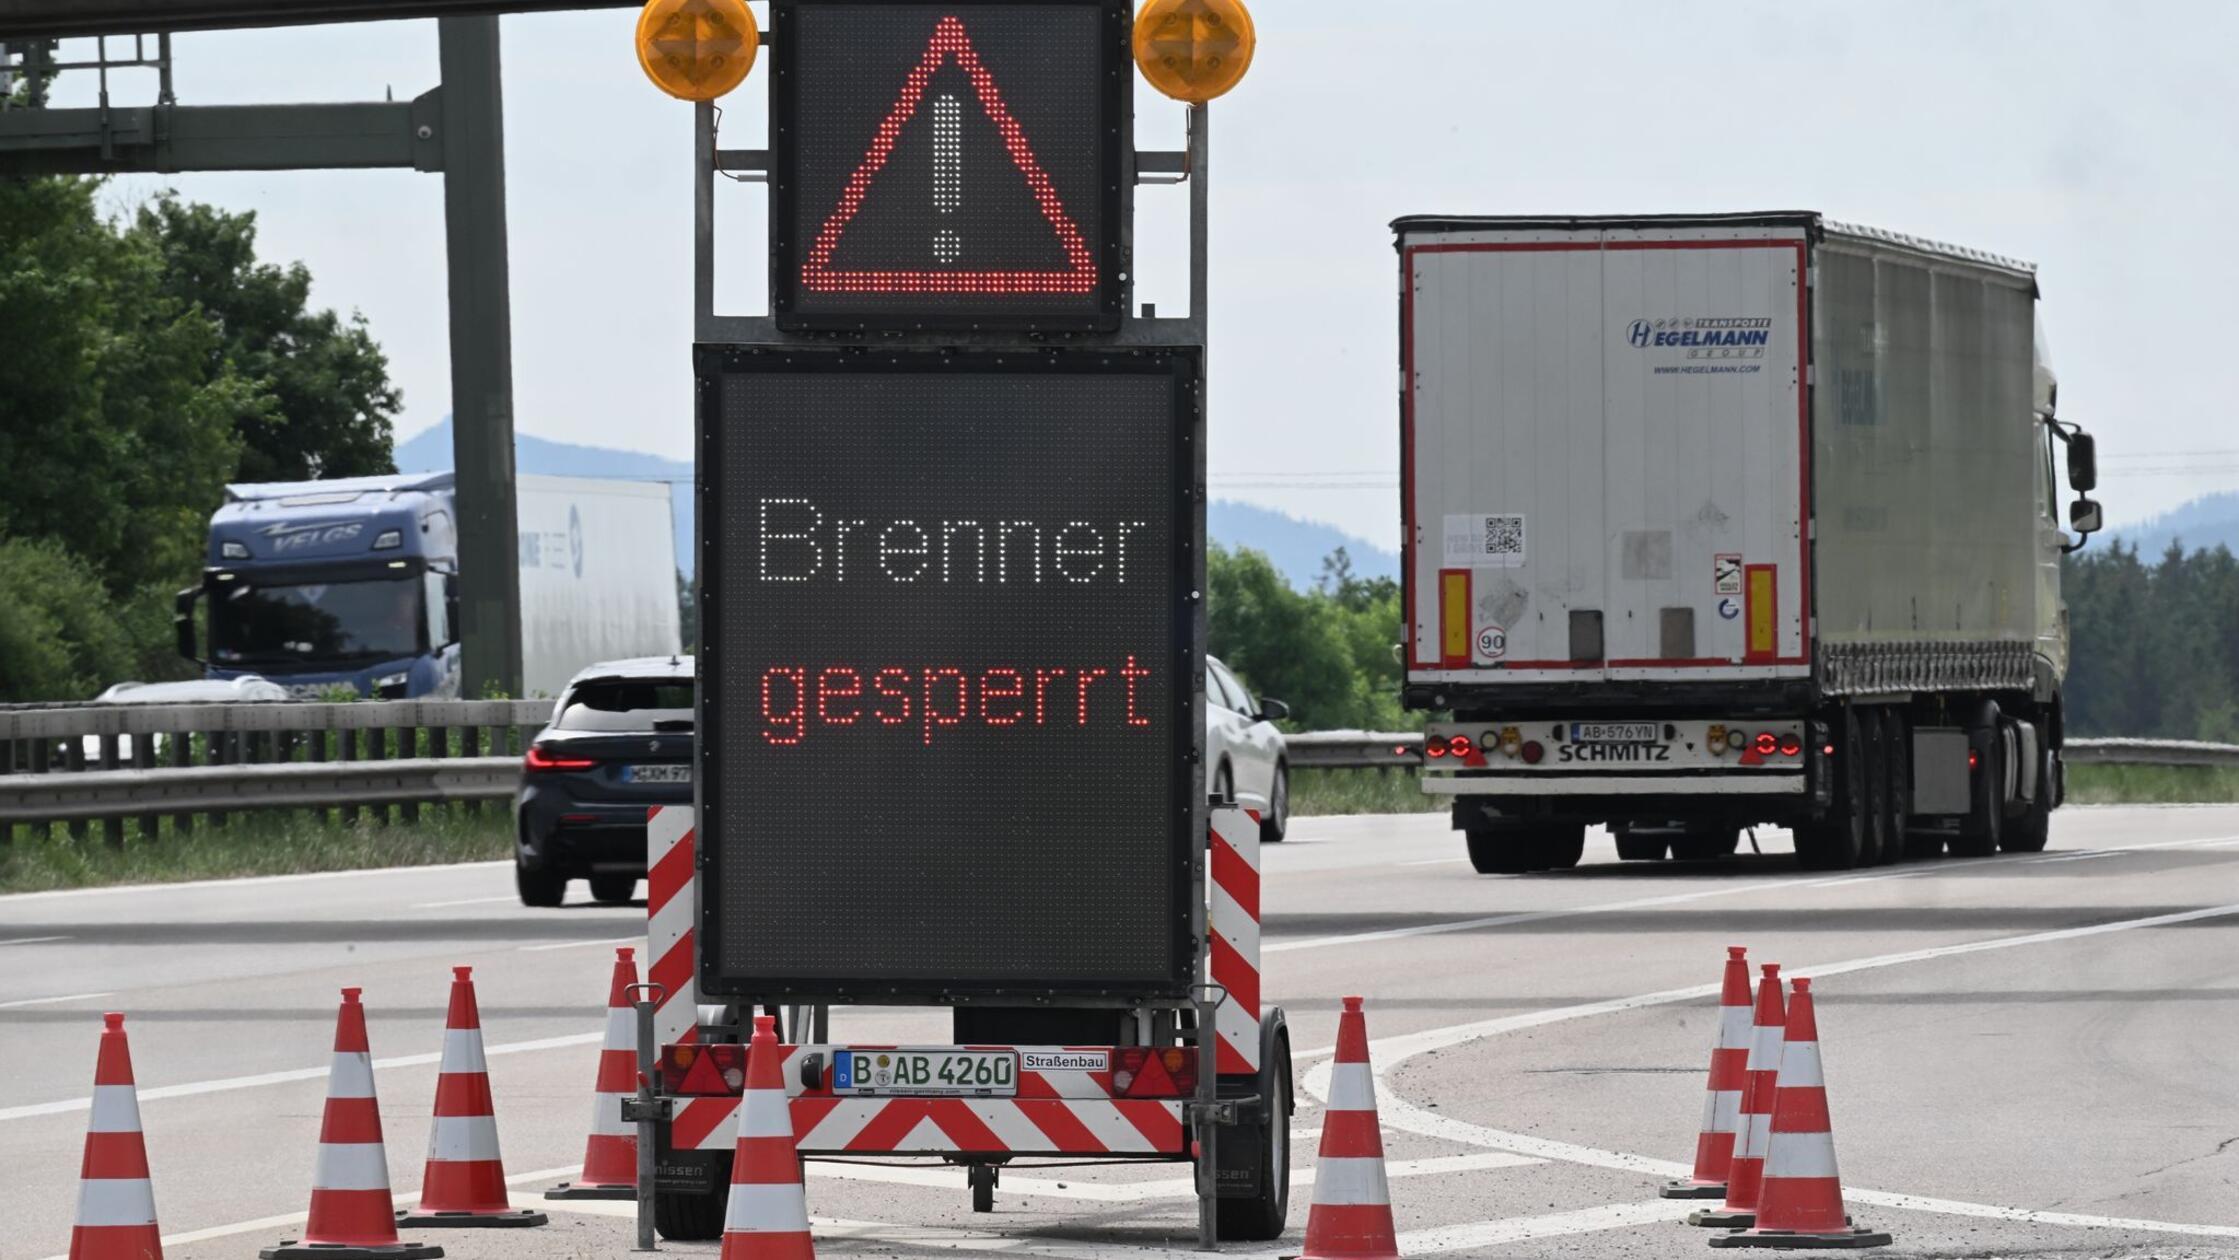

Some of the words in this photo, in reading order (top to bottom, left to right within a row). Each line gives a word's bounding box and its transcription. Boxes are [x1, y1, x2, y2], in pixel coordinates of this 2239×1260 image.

[1696, 319, 1770, 328] TRANSPORTE
[1629, 320, 1769, 347] HEGELMANN
[761, 498, 1146, 583] Brenner
[1481, 635, 1505, 649] 90
[762, 654, 1150, 745] gesperrt
[1559, 744, 1670, 761] SCHMITZ
[1026, 1055, 1104, 1067] Straßenbau
[853, 1056, 871, 1084] B
[893, 1056, 930, 1085] AB
[937, 1056, 1012, 1085] 4260
[1216, 1169, 1248, 1179] ssen
